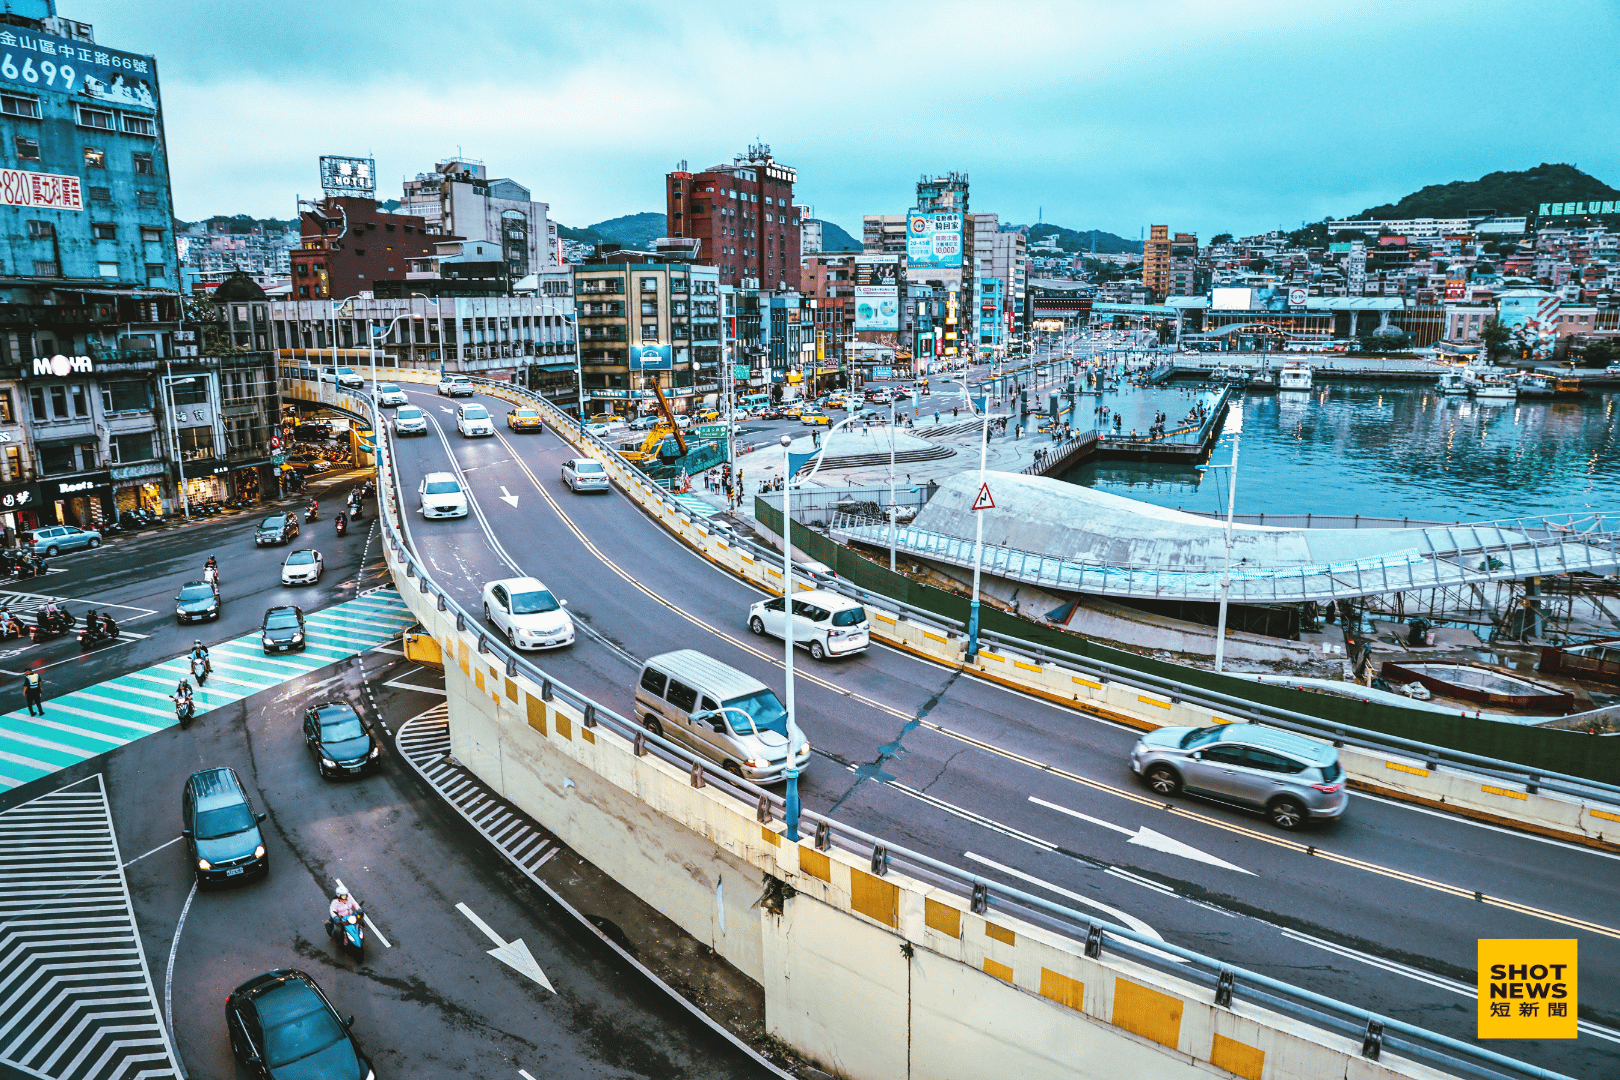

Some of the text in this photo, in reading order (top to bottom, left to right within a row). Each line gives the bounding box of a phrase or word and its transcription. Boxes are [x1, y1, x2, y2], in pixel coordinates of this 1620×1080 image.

[0, 31, 149, 74] 金山區中正路66號
[1, 53, 76, 90] 6699
[335, 171, 373, 188] HOTEL
[34, 354, 93, 376] MOYA
